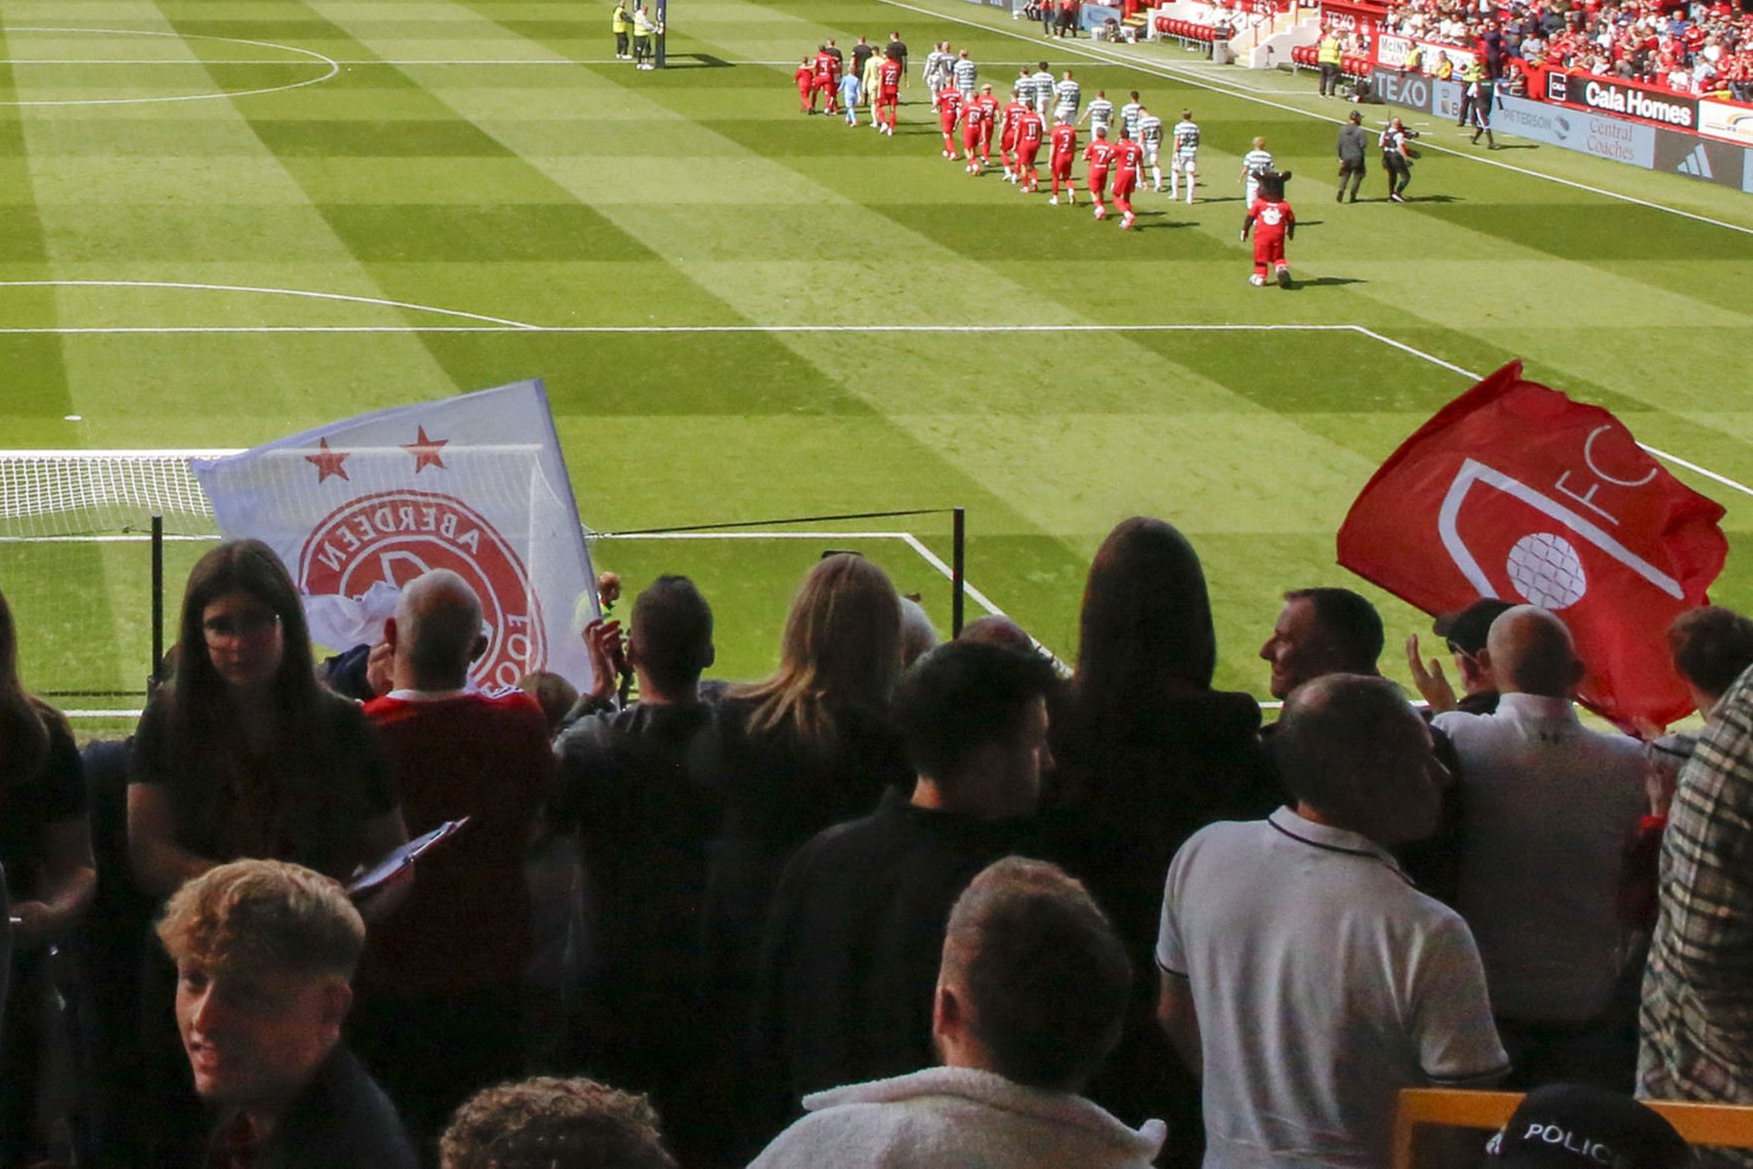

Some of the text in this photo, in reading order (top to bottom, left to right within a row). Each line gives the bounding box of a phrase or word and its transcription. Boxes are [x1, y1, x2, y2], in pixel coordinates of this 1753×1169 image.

[1326, 10, 1356, 32] TEXO
[1374, 72, 1427, 107] TEXO
[1585, 80, 1692, 127] Cala Homes
[1502, 108, 1552, 131] PETERSON
[1589, 117, 1633, 143] Central
[1098, 150, 1106, 163] 7
[1586, 136, 1635, 161] Coaches
[1554, 424, 1658, 526] FC
[1523, 1123, 1615, 1164] POLIC
